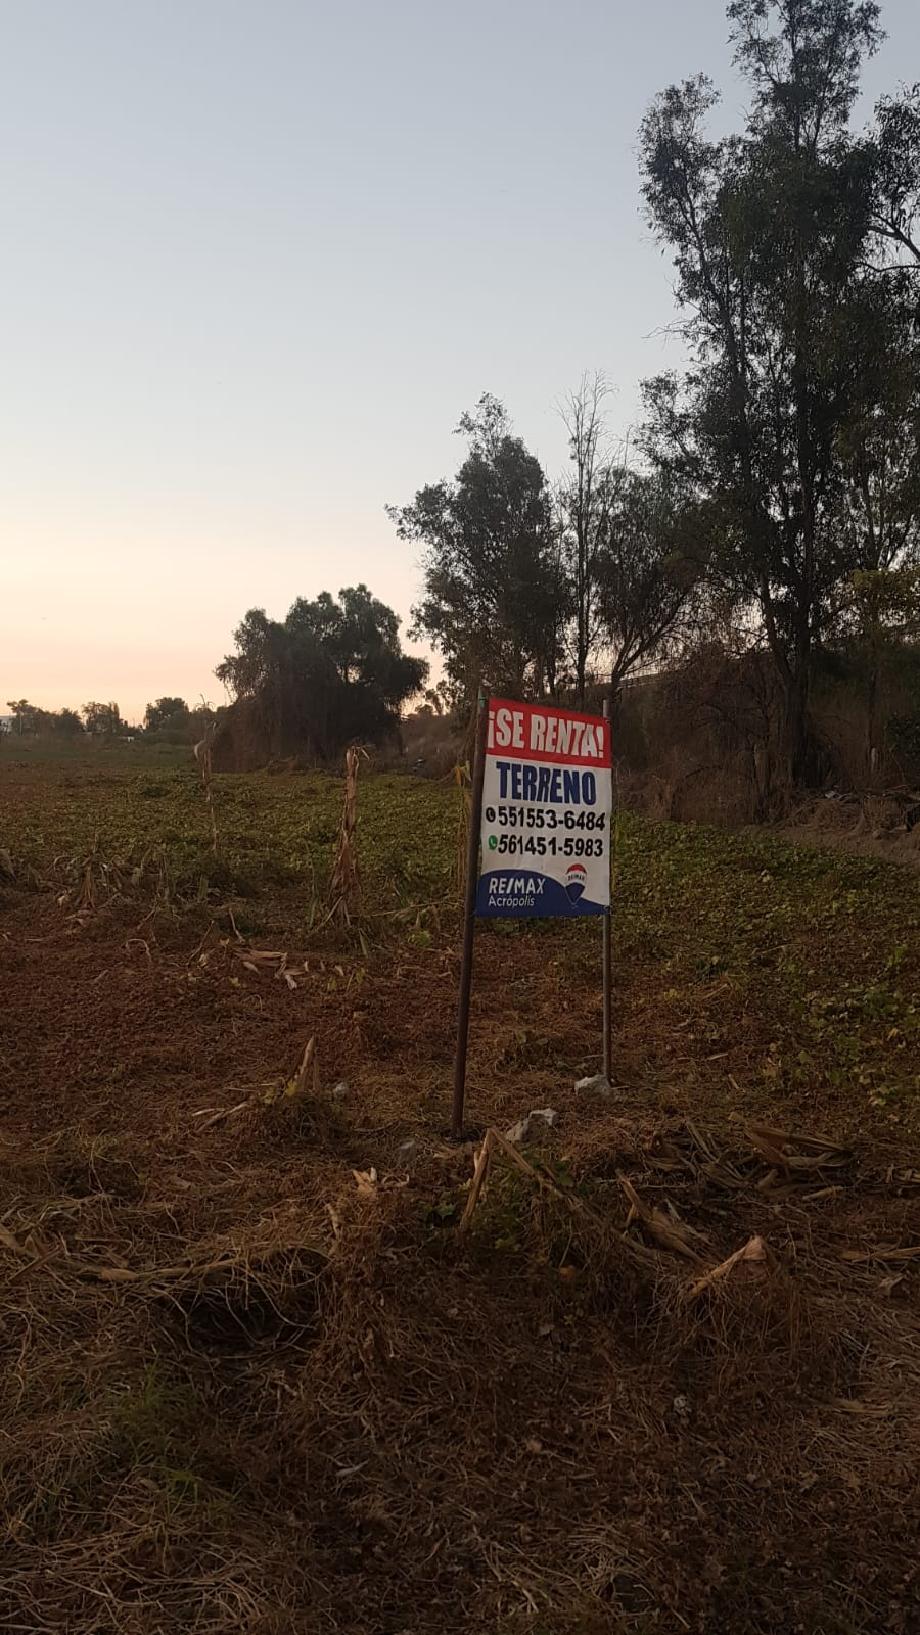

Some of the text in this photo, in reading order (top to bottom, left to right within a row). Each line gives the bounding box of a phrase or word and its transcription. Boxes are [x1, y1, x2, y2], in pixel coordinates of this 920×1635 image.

[487, 708, 604, 759] ¡SE RENTA!
[496, 761, 597, 806] TERRENO
[498, 805, 606, 831] 551553-6484
[498, 834, 603, 857] 561451-5983
[488, 877, 546, 895] RE/MAX
[488, 894, 535, 907] Acrópolis
